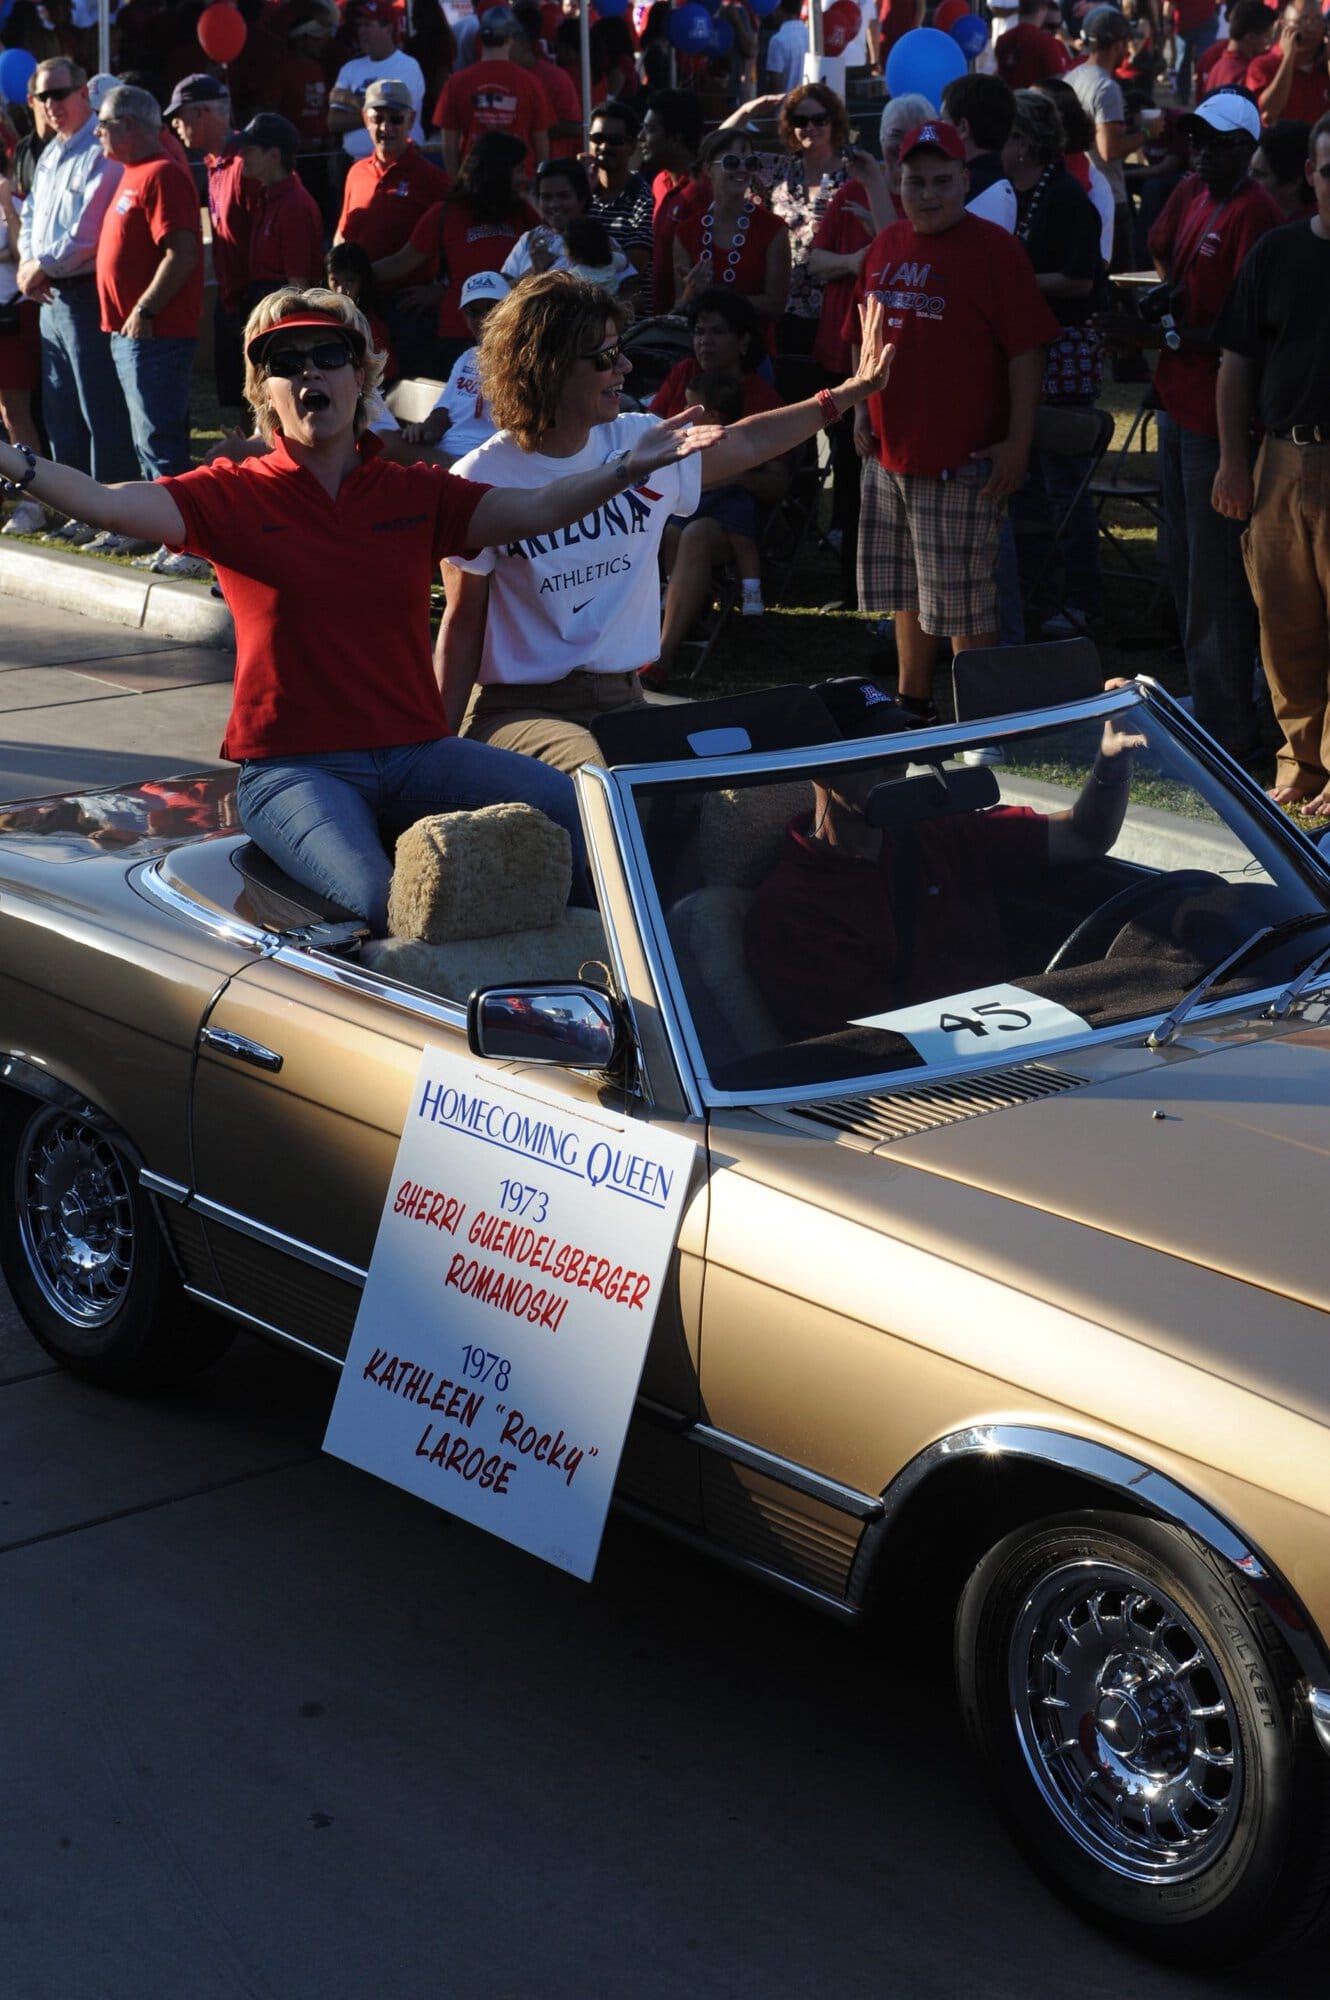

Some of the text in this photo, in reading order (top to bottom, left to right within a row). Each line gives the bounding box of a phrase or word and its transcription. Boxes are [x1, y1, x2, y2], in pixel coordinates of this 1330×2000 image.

[917, 125, 940, 143] A
[889, 262, 931, 288] AM
[539, 554, 632, 594] ATHLETICS
[940, 1002, 1032, 1037] 45
[418, 1079, 674, 1202] HOMECOMING QUEEN
[499, 1178, 550, 1224] 1973
[393, 1180, 651, 1311] SHERRI GUENDELSBERGER
[444, 1252, 569, 1333] ROMANOSKI
[362, 1347, 485, 1429] KATHLEEN
[461, 1344, 512, 1392] 1978
[415, 1423, 517, 1495] LAROSE
[1213, 1601, 1277, 1729] FALKEN
